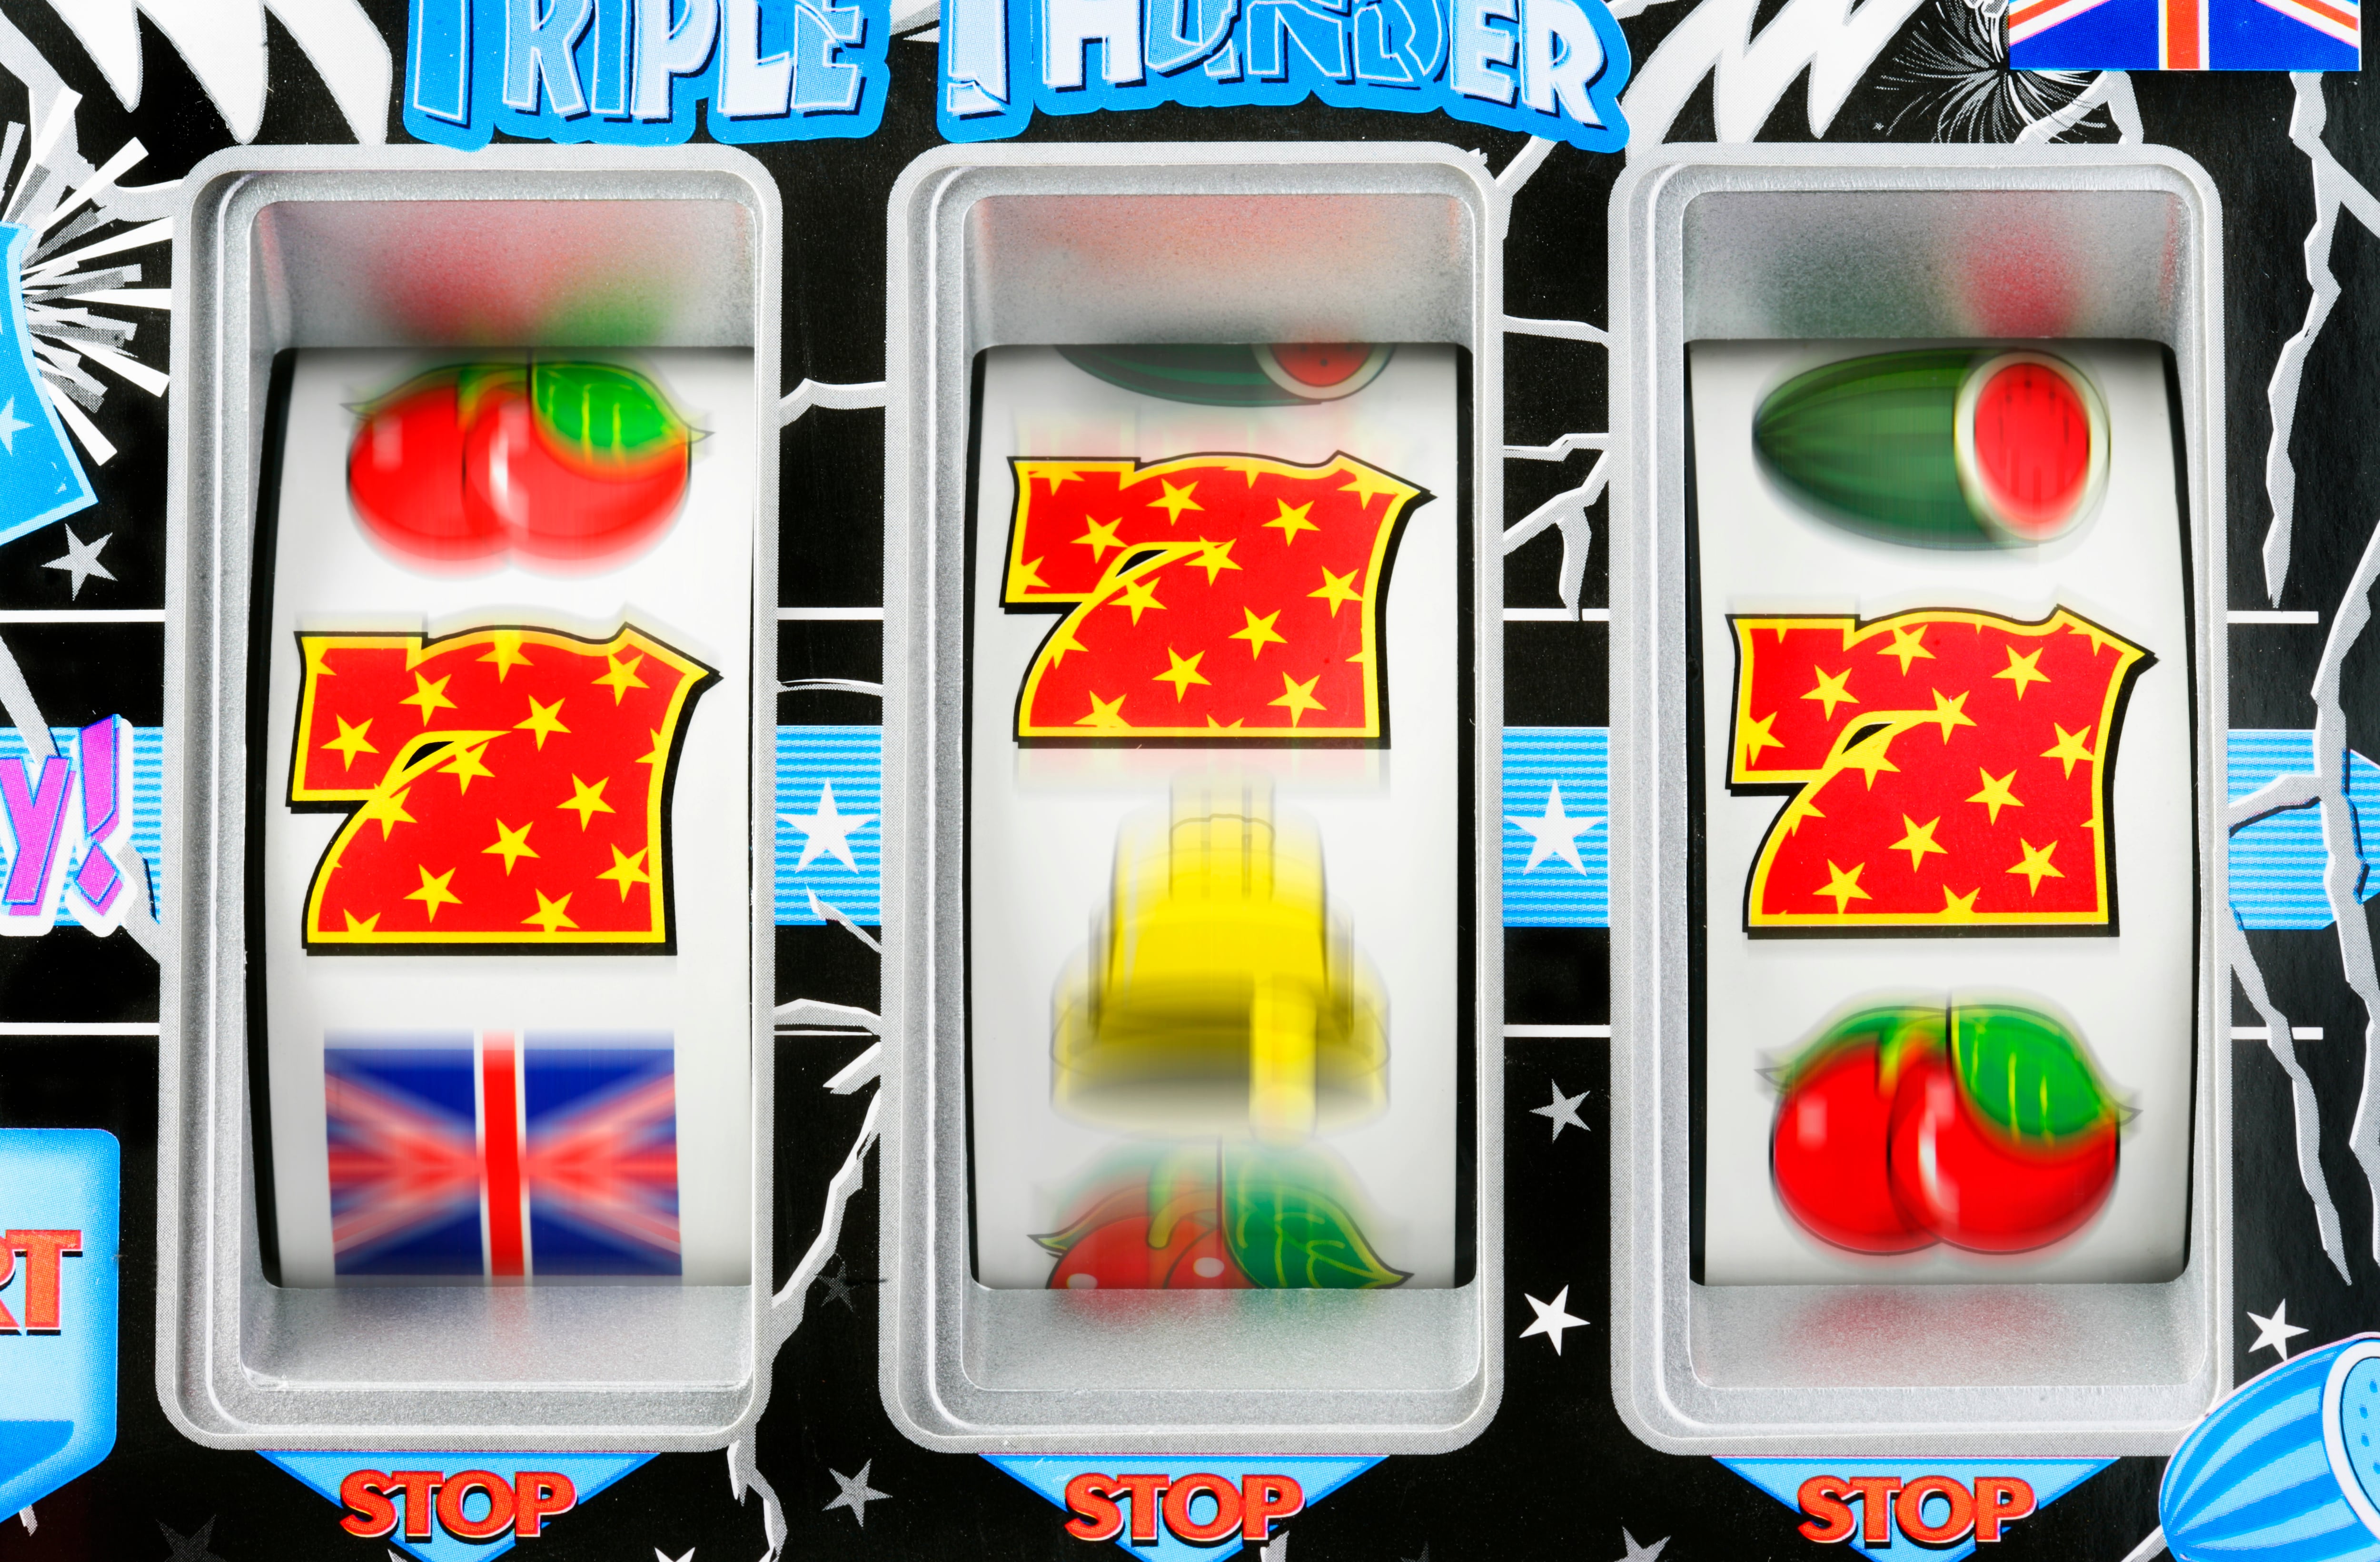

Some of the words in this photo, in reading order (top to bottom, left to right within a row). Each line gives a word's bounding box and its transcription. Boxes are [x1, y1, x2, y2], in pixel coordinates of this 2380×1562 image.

[413, 0, 866, 128] TRIPLE
[946, 0, 1608, 129] THUNDER
[339, 1469, 577, 1545] STOP
[1064, 1473, 1305, 1548] STOP
[1797, 1475, 2037, 1550] STOP
